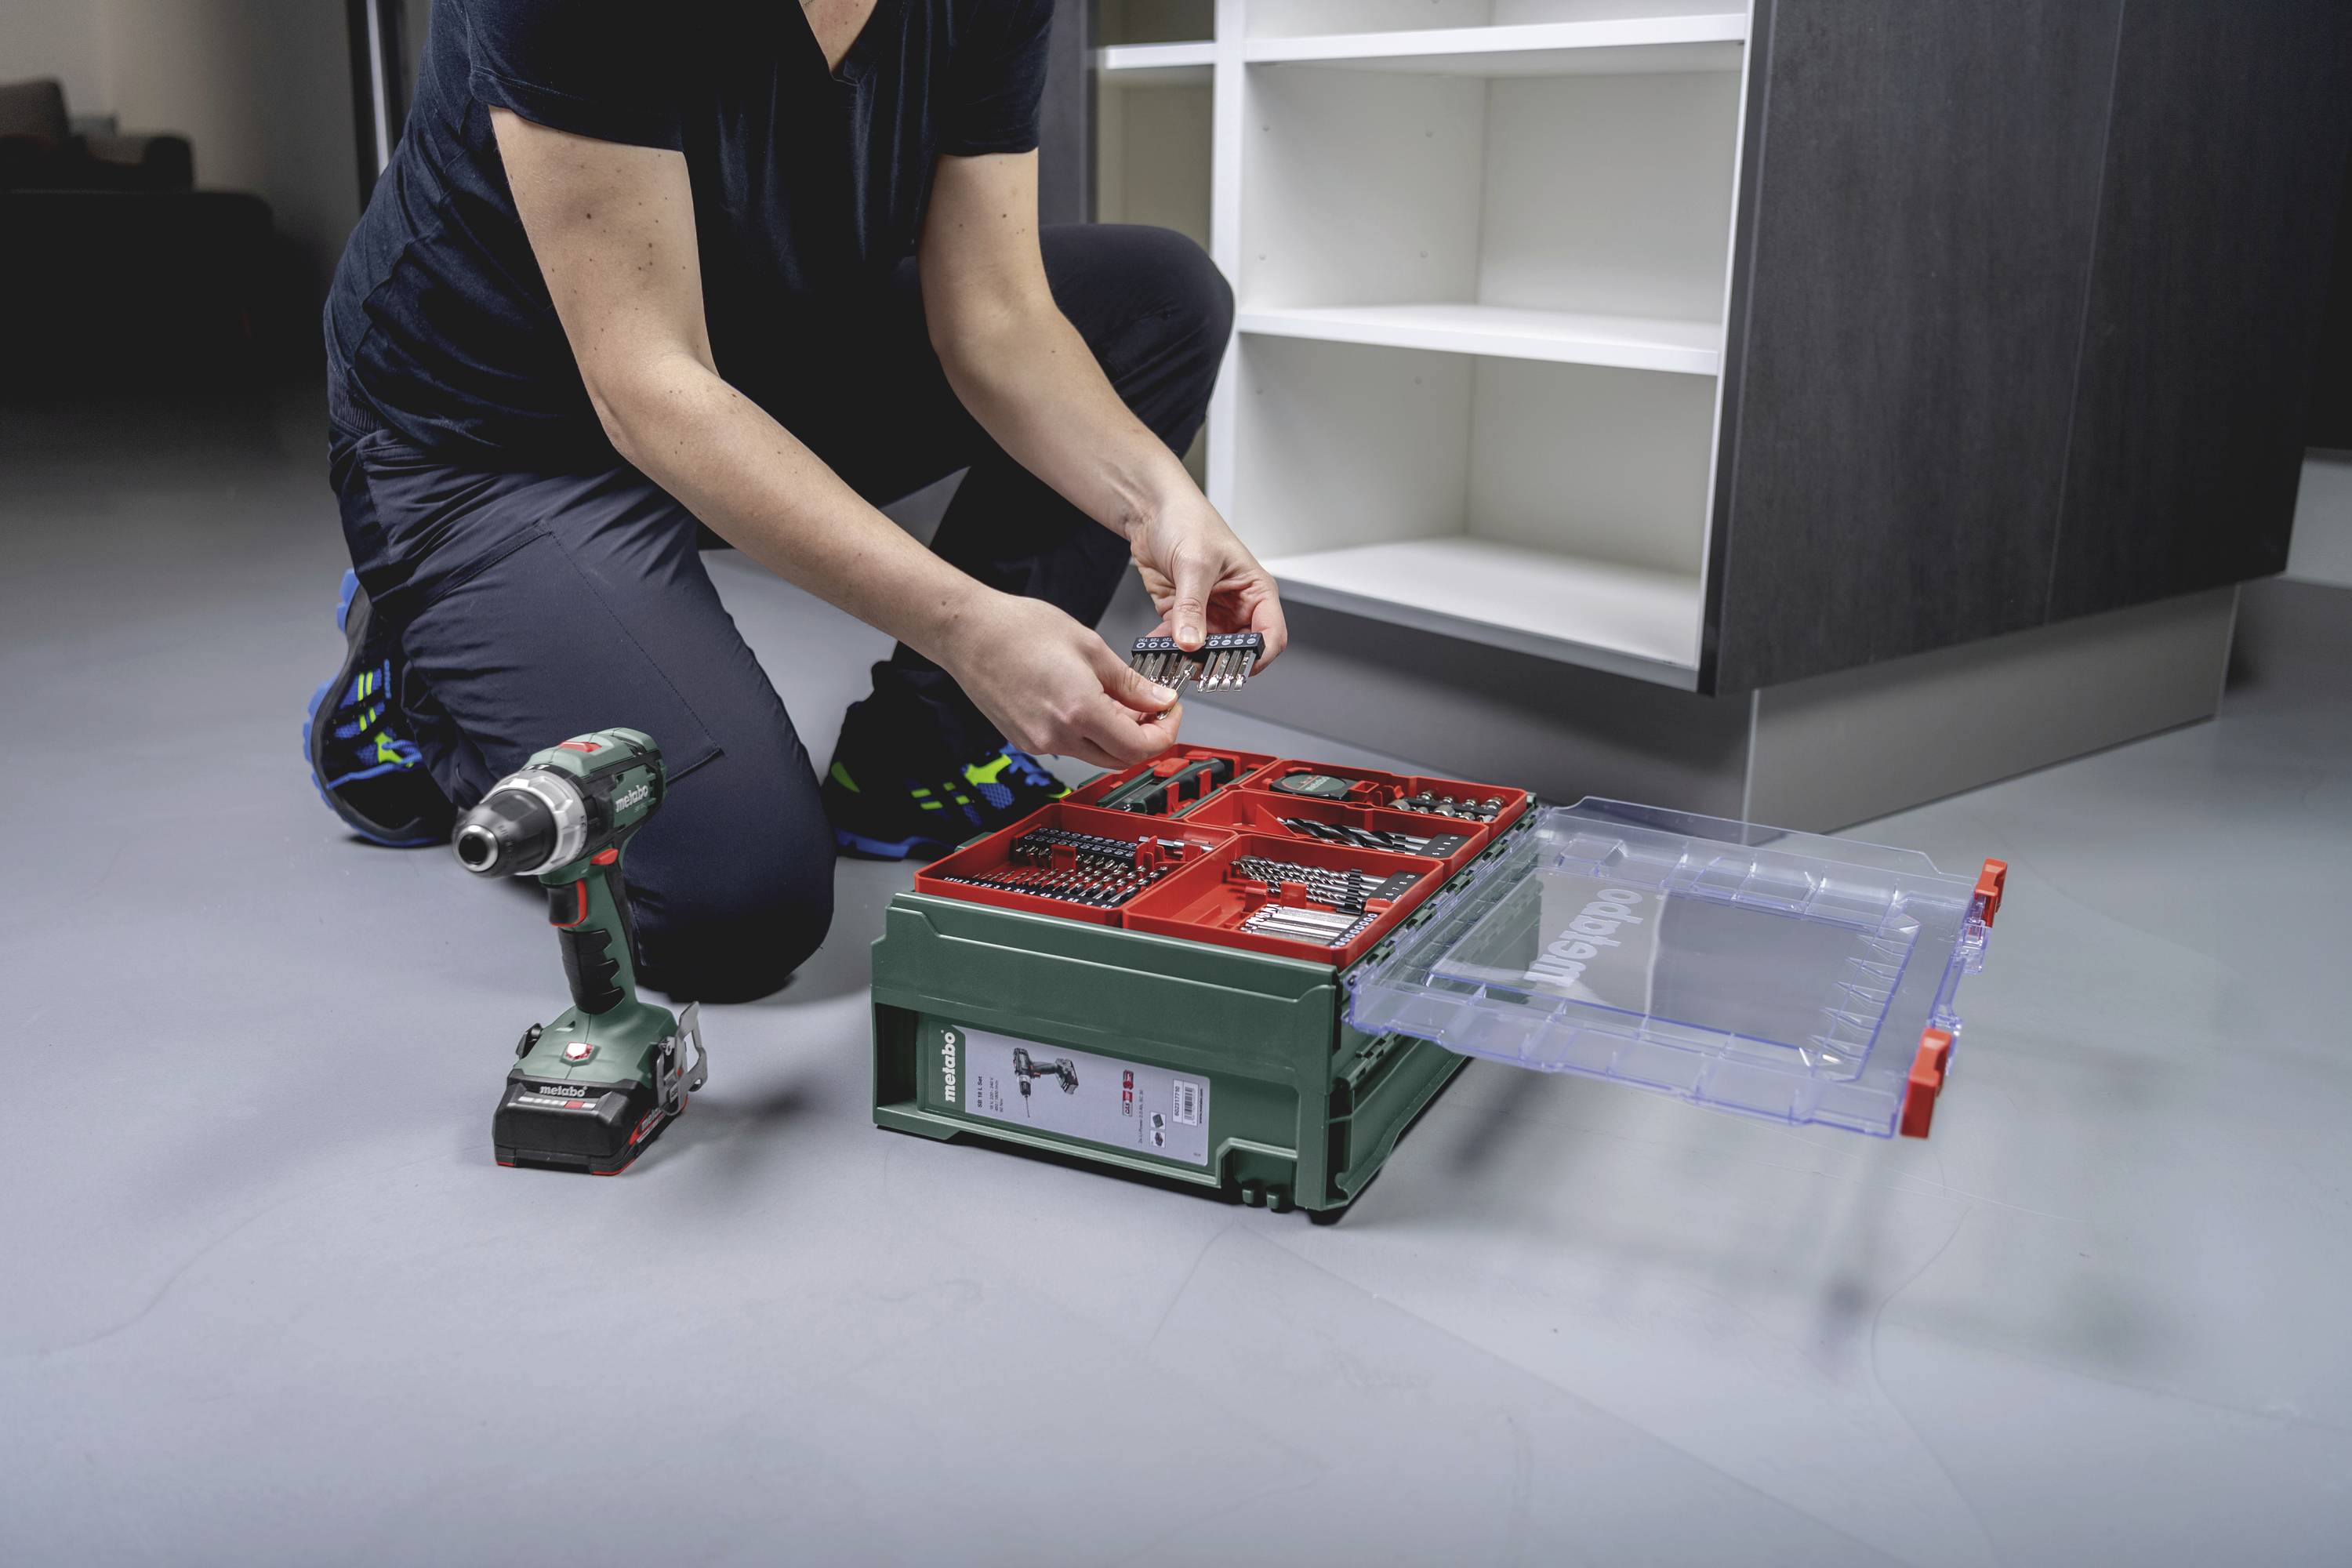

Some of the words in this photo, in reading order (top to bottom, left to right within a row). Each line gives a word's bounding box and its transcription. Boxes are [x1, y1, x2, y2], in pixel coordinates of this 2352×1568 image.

[615, 785, 648, 813] metabo
[942, 1032, 956, 1102] metabo
[539, 1085, 586, 1098] metabo
